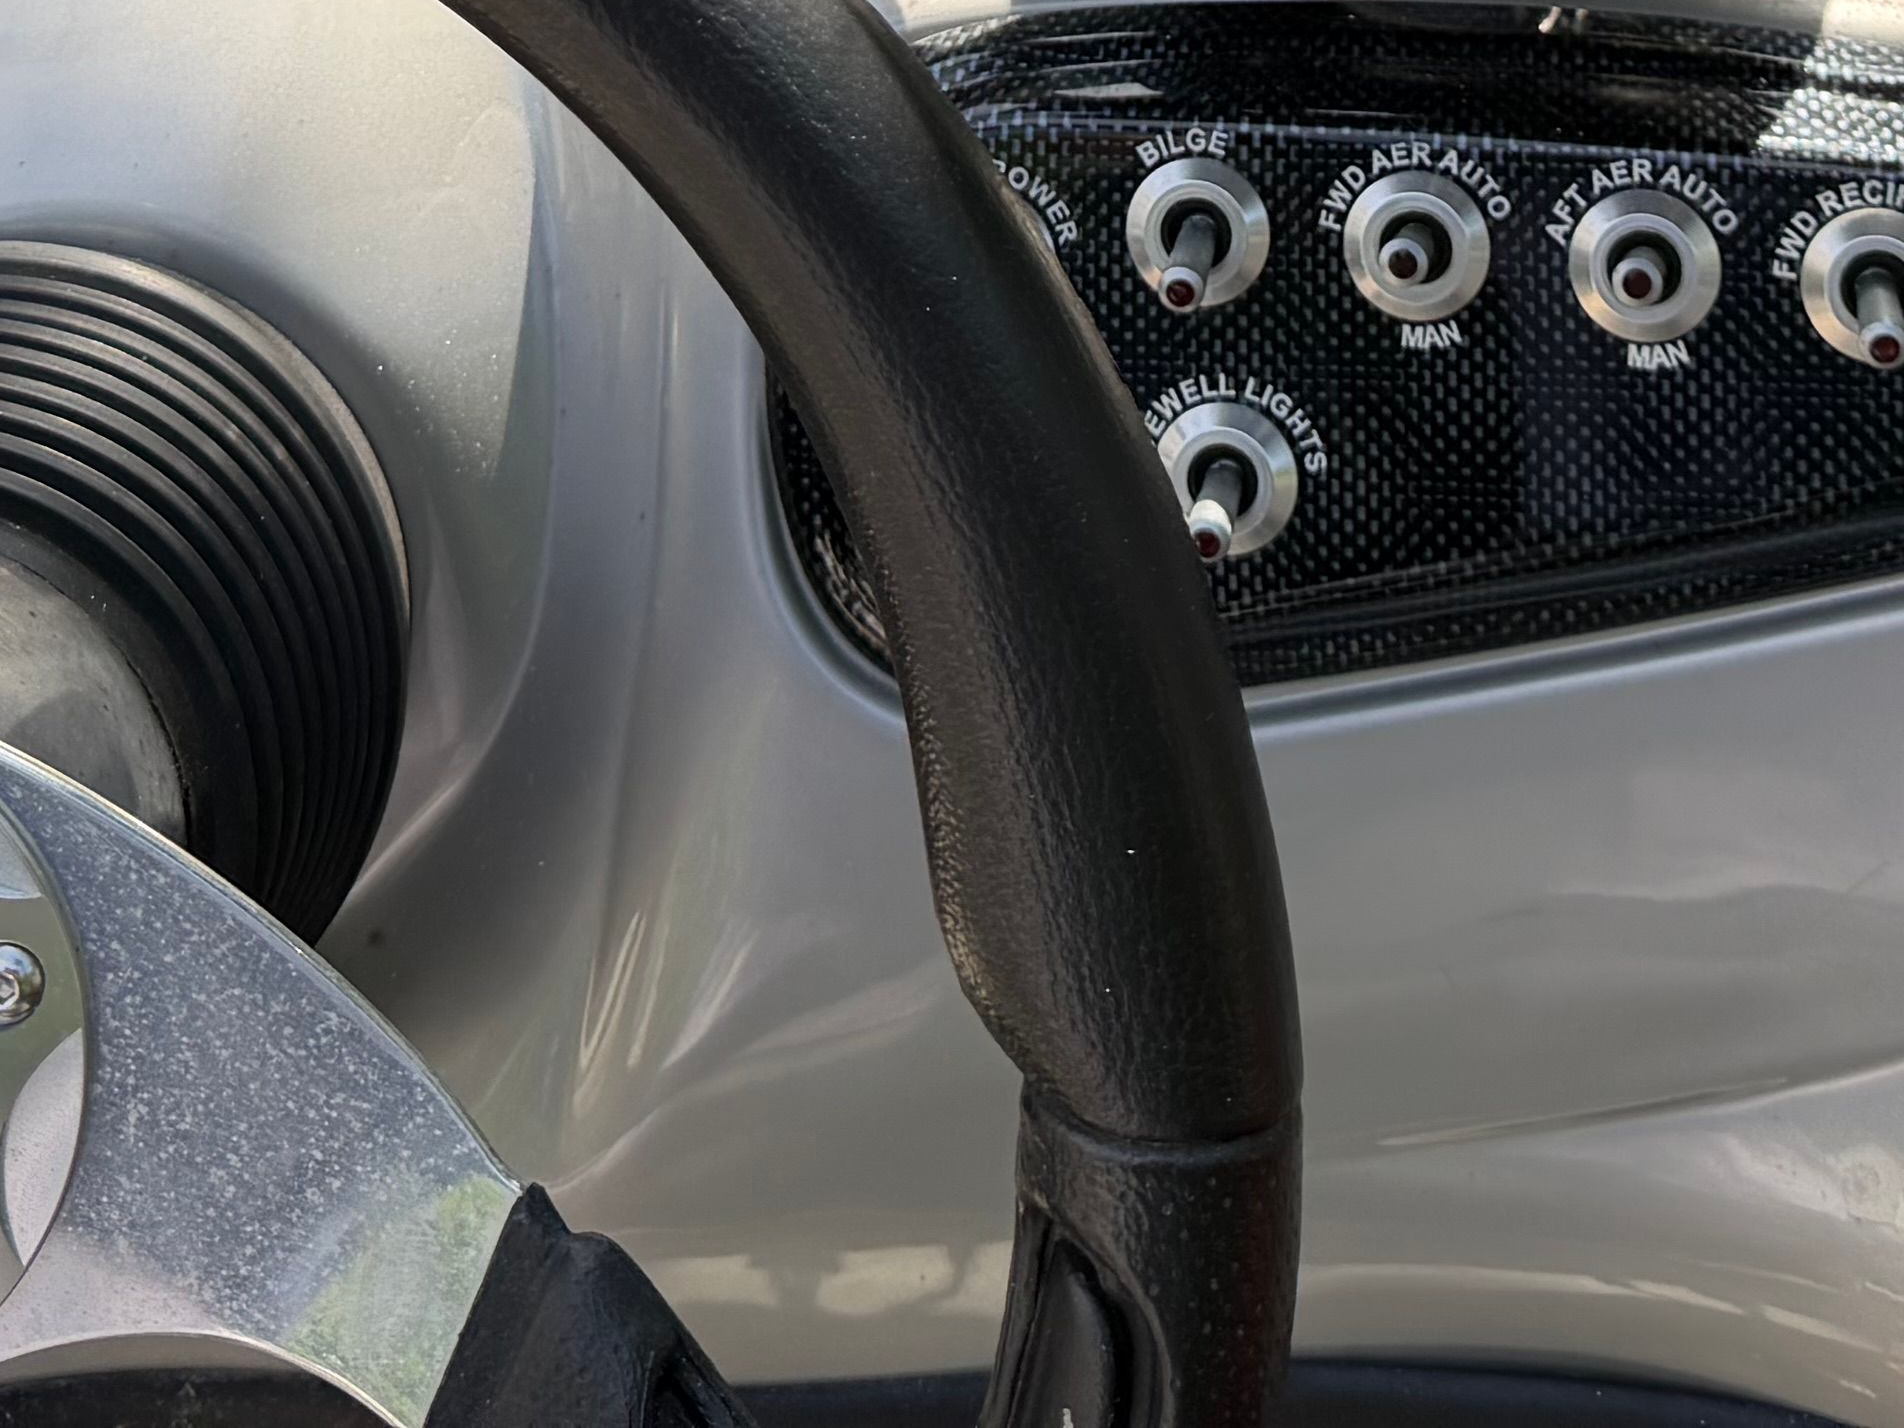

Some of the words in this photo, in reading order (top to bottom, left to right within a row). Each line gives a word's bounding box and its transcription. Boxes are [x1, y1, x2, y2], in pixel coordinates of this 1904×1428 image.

[1135, 128, 1229, 168] BILGE
[1319, 164, 1367, 232] FWD
[1371, 142, 1432, 176] AER
[1439, 150, 1511, 221] AUTO
[1545, 182, 1589, 246] AFT
[1591, 158, 1653, 193] AER
[1660, 165, 1739, 235] AUTO
[1773, 210, 1818, 281] FWD
[1401, 320, 1462, 352] MAN
[1628, 340, 1691, 372] MAN
[1144, 372, 1236, 447] EWELL
[1245, 376, 1328, 477] LIGHTS
